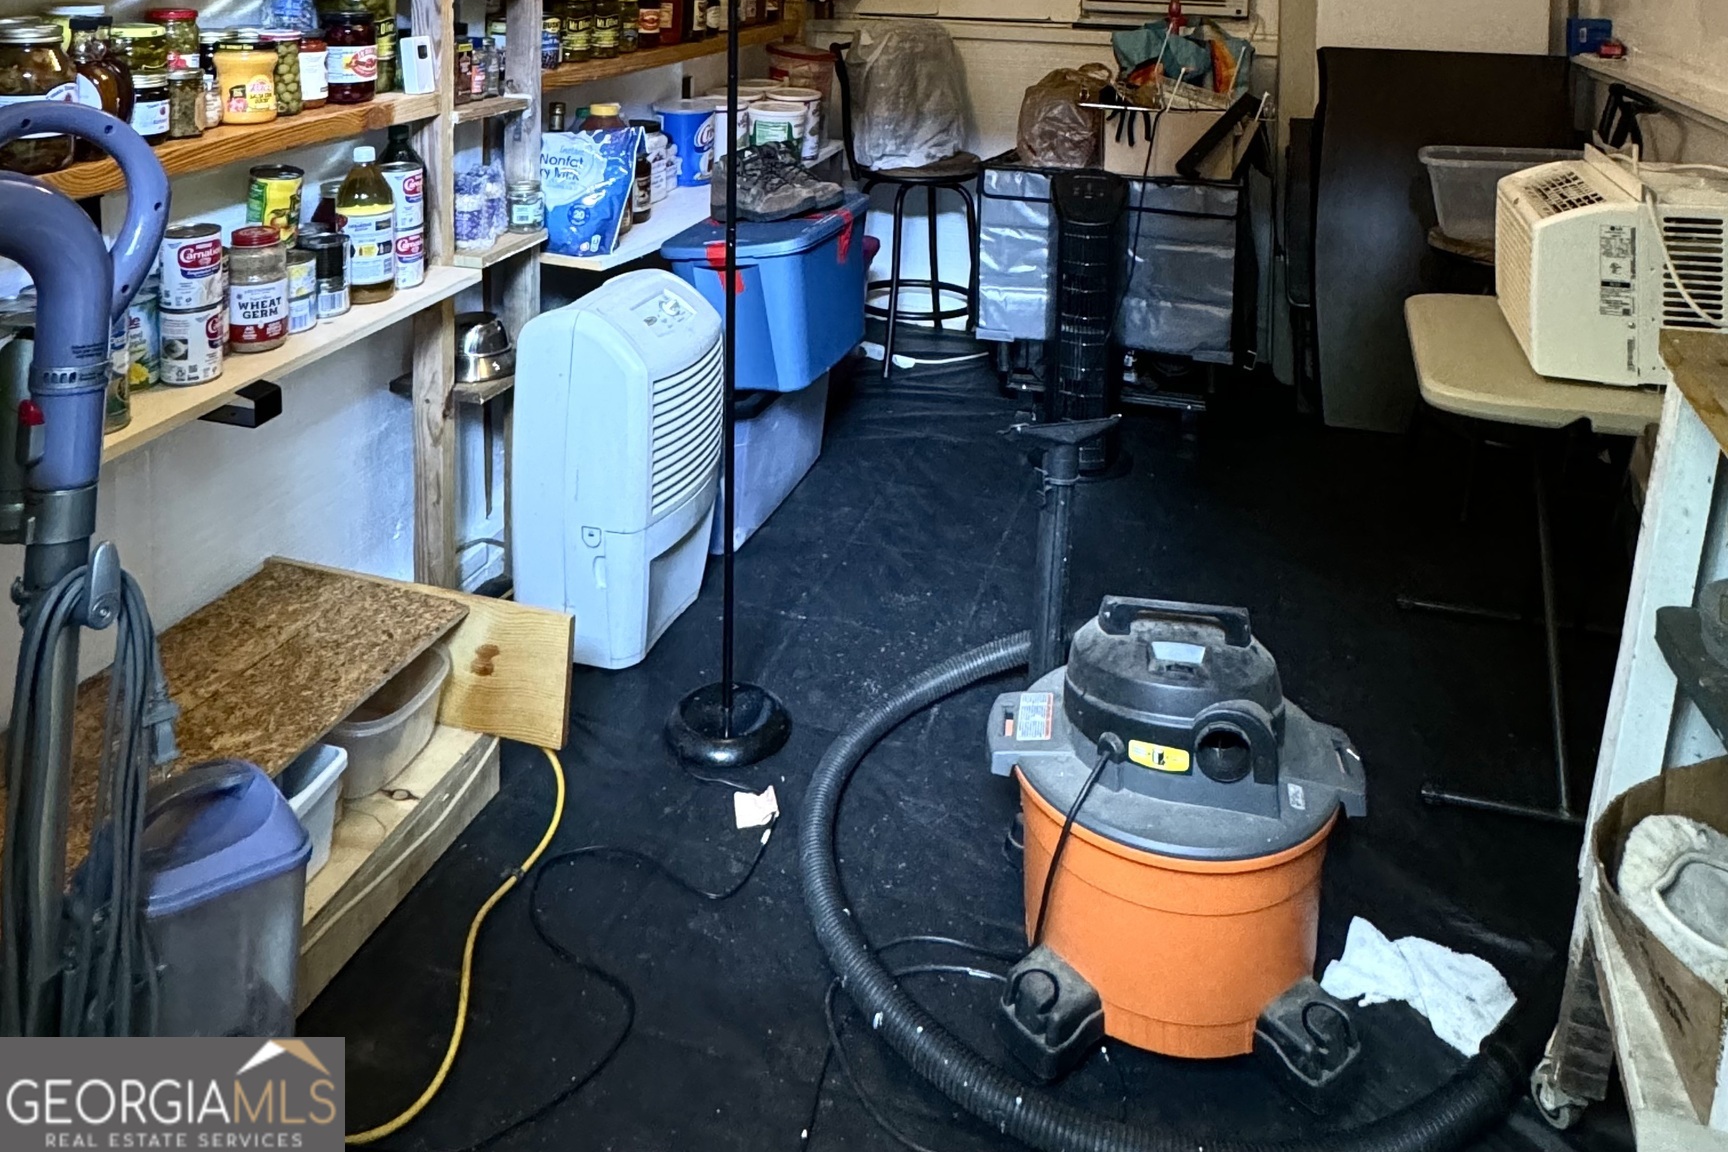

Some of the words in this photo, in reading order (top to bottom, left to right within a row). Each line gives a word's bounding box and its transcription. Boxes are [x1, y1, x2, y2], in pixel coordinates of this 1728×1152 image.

[540, 153, 584, 168] Nonfat
[238, 296, 282, 311] WHEAT
[242, 307, 279, 320] GERM
